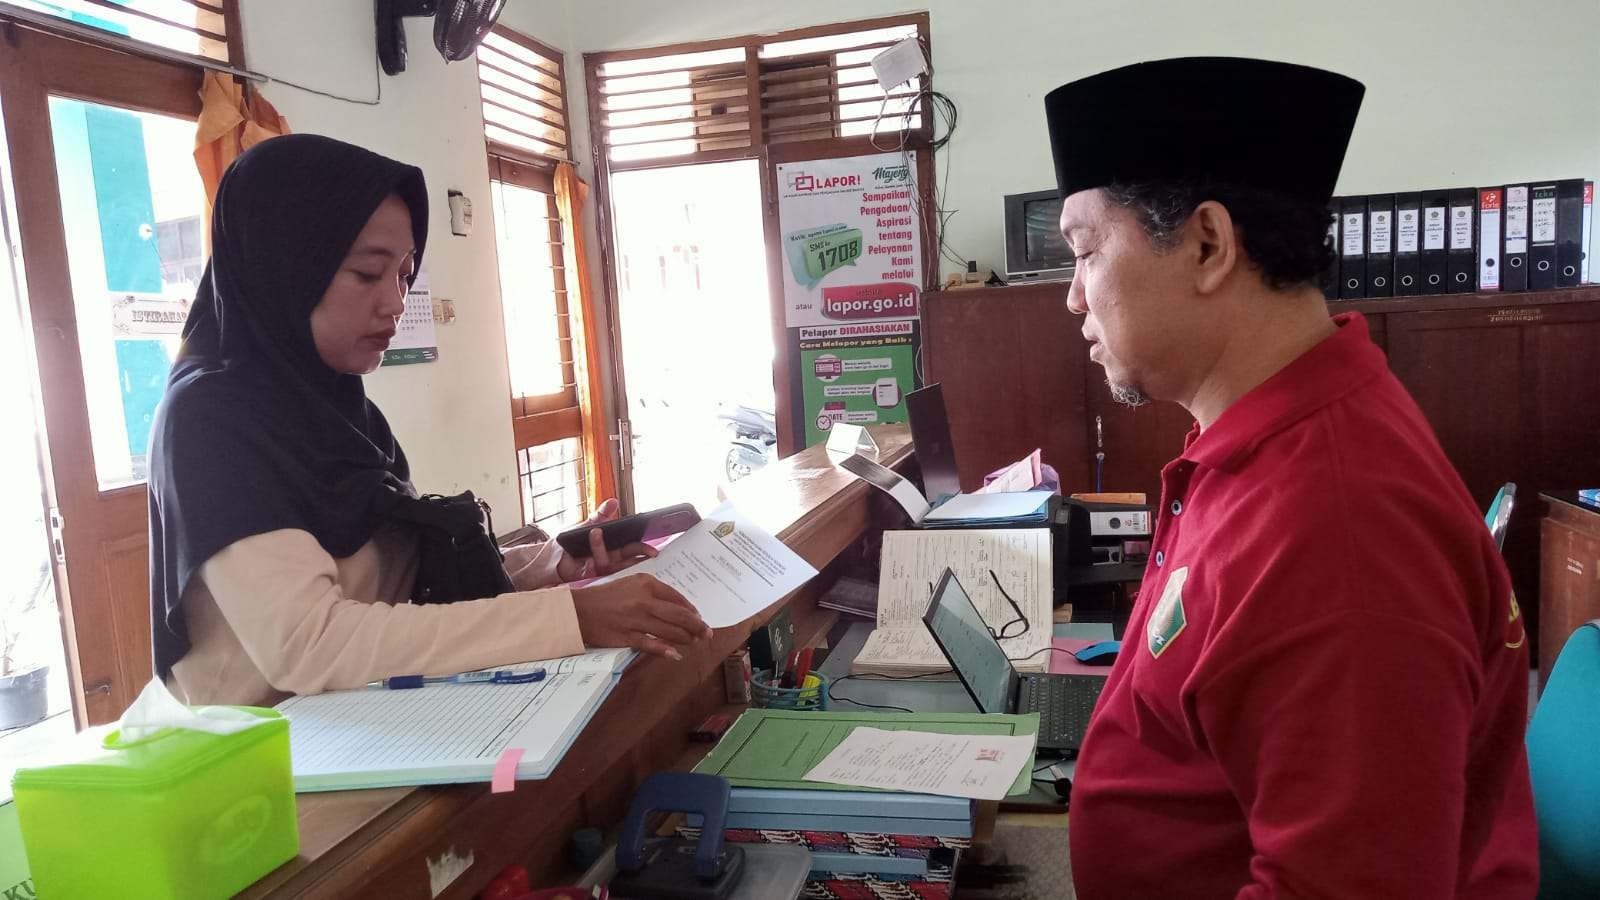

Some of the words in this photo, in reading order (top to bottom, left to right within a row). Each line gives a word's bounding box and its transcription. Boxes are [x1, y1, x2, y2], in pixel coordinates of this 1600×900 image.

[816, 175, 861, 188] LAPOR!
[863, 191, 911, 202] Sampaikan
[860, 204, 912, 216] Pengaduan/
[876, 217, 912, 228] Aspirasi
[879, 230, 912, 241] tentang
[809, 242, 824, 252] SMS
[868, 244, 912, 255] Pelayanan
[818, 240, 858, 272] 1708
[891, 257, 913, 266] Kami
[882, 268, 914, 280] melalui
[827, 293, 914, 315] lapor.go.id
[802, 329, 837, 338] Pelapor
[839, 324, 910, 335] DIRAHASIAKAN
[822, 340, 858, 348] Melapor
[861, 339, 883, 347] yang
